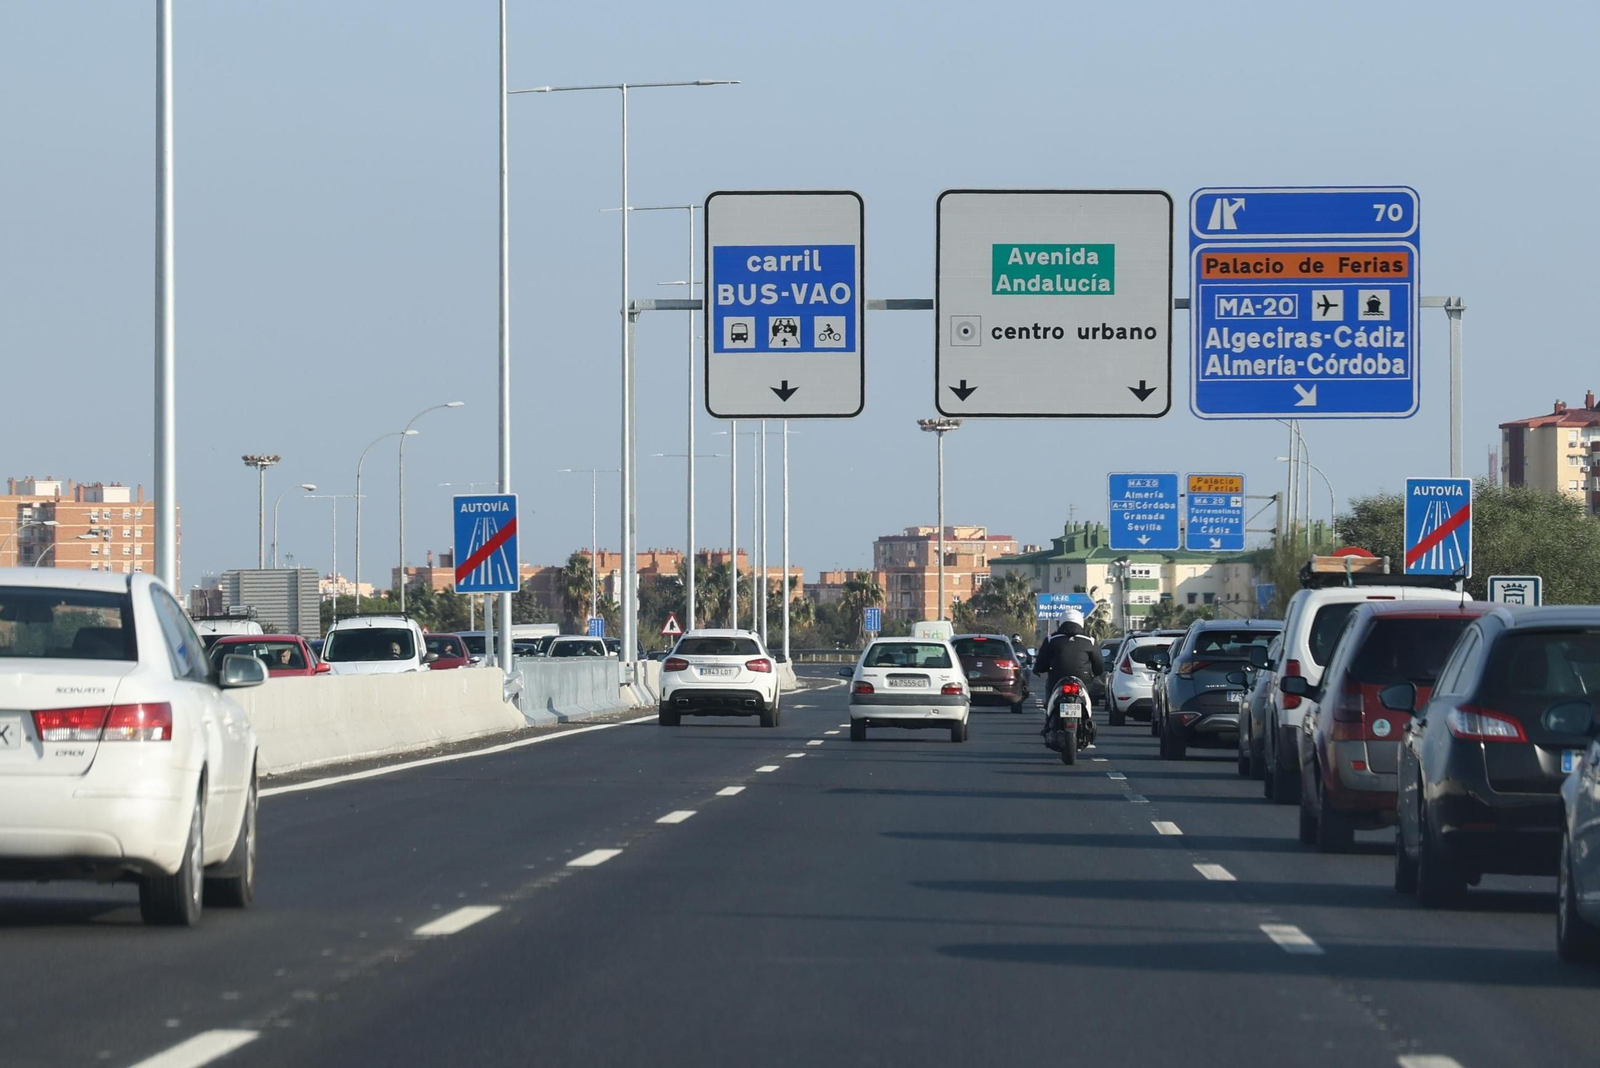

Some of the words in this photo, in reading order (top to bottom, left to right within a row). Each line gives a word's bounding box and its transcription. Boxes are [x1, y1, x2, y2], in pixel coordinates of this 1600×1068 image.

[1372, 203, 1404, 222] 70
[746, 249, 822, 272] carril
[1007, 247, 1099, 266] Avenida
[1205, 257, 1284, 274] Palacio
[1298, 257, 1324, 273] de
[1338, 256, 1404, 273] Ferias
[995, 273, 1111, 292] Andalucía
[717, 282, 852, 306] BUS-VAO
[1218, 297, 1294, 316] MA-20
[991, 322, 1065, 340] centro
[1077, 322, 1157, 340] urbano
[1204, 325, 1405, 353] Algeciras-Cádiz
[1204, 352, 1405, 376] Almería-Córdoba
[1128, 479, 1159, 487] MA-20
[1196, 477, 1234, 485] Palacio
[1124, 490, 1164, 499] Almería
[1413, 484, 1463, 496] AUTOVÍA
[460, 500, 510, 513] AUTOVÍA
[1135, 501, 1176, 510] Córdoba
[1194, 497, 1225, 505] MA-20
[1123, 512, 1165, 520] Granada
[1190, 507, 1241, 515] Torremolinos
[1190, 515, 1240, 525] Algeciras
[1127, 522, 1162, 531] Sevilla
[1200, 525, 1231, 534] Cádiz
[55, 686, 105, 695] SONATA
